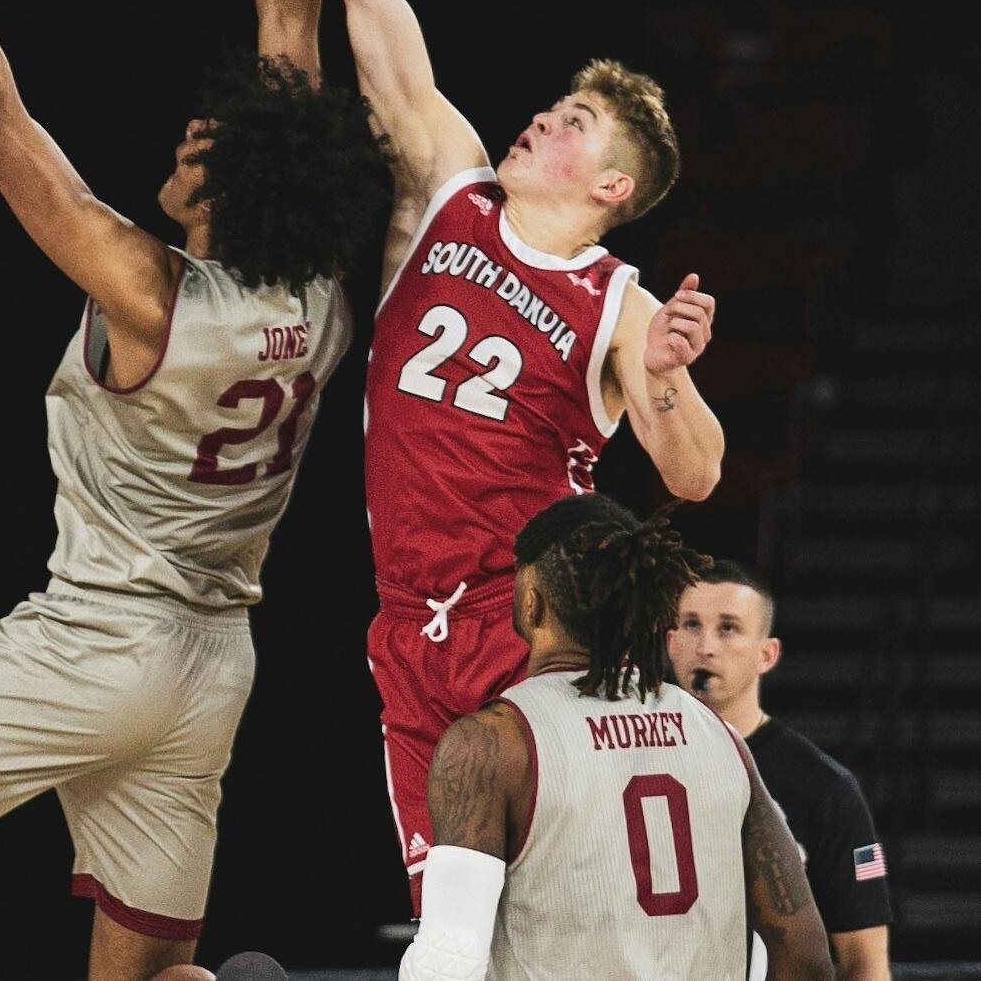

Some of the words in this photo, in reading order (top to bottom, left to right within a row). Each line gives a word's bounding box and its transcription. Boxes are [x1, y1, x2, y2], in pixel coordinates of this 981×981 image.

[421, 241, 503, 288] SOUTH
[258, 321, 311, 362] JONE
[398, 304, 523, 422] 22
[188, 370, 316, 486] 21
[585, 712, 687, 750] MURKEY
[622, 773, 699, 917] 0
